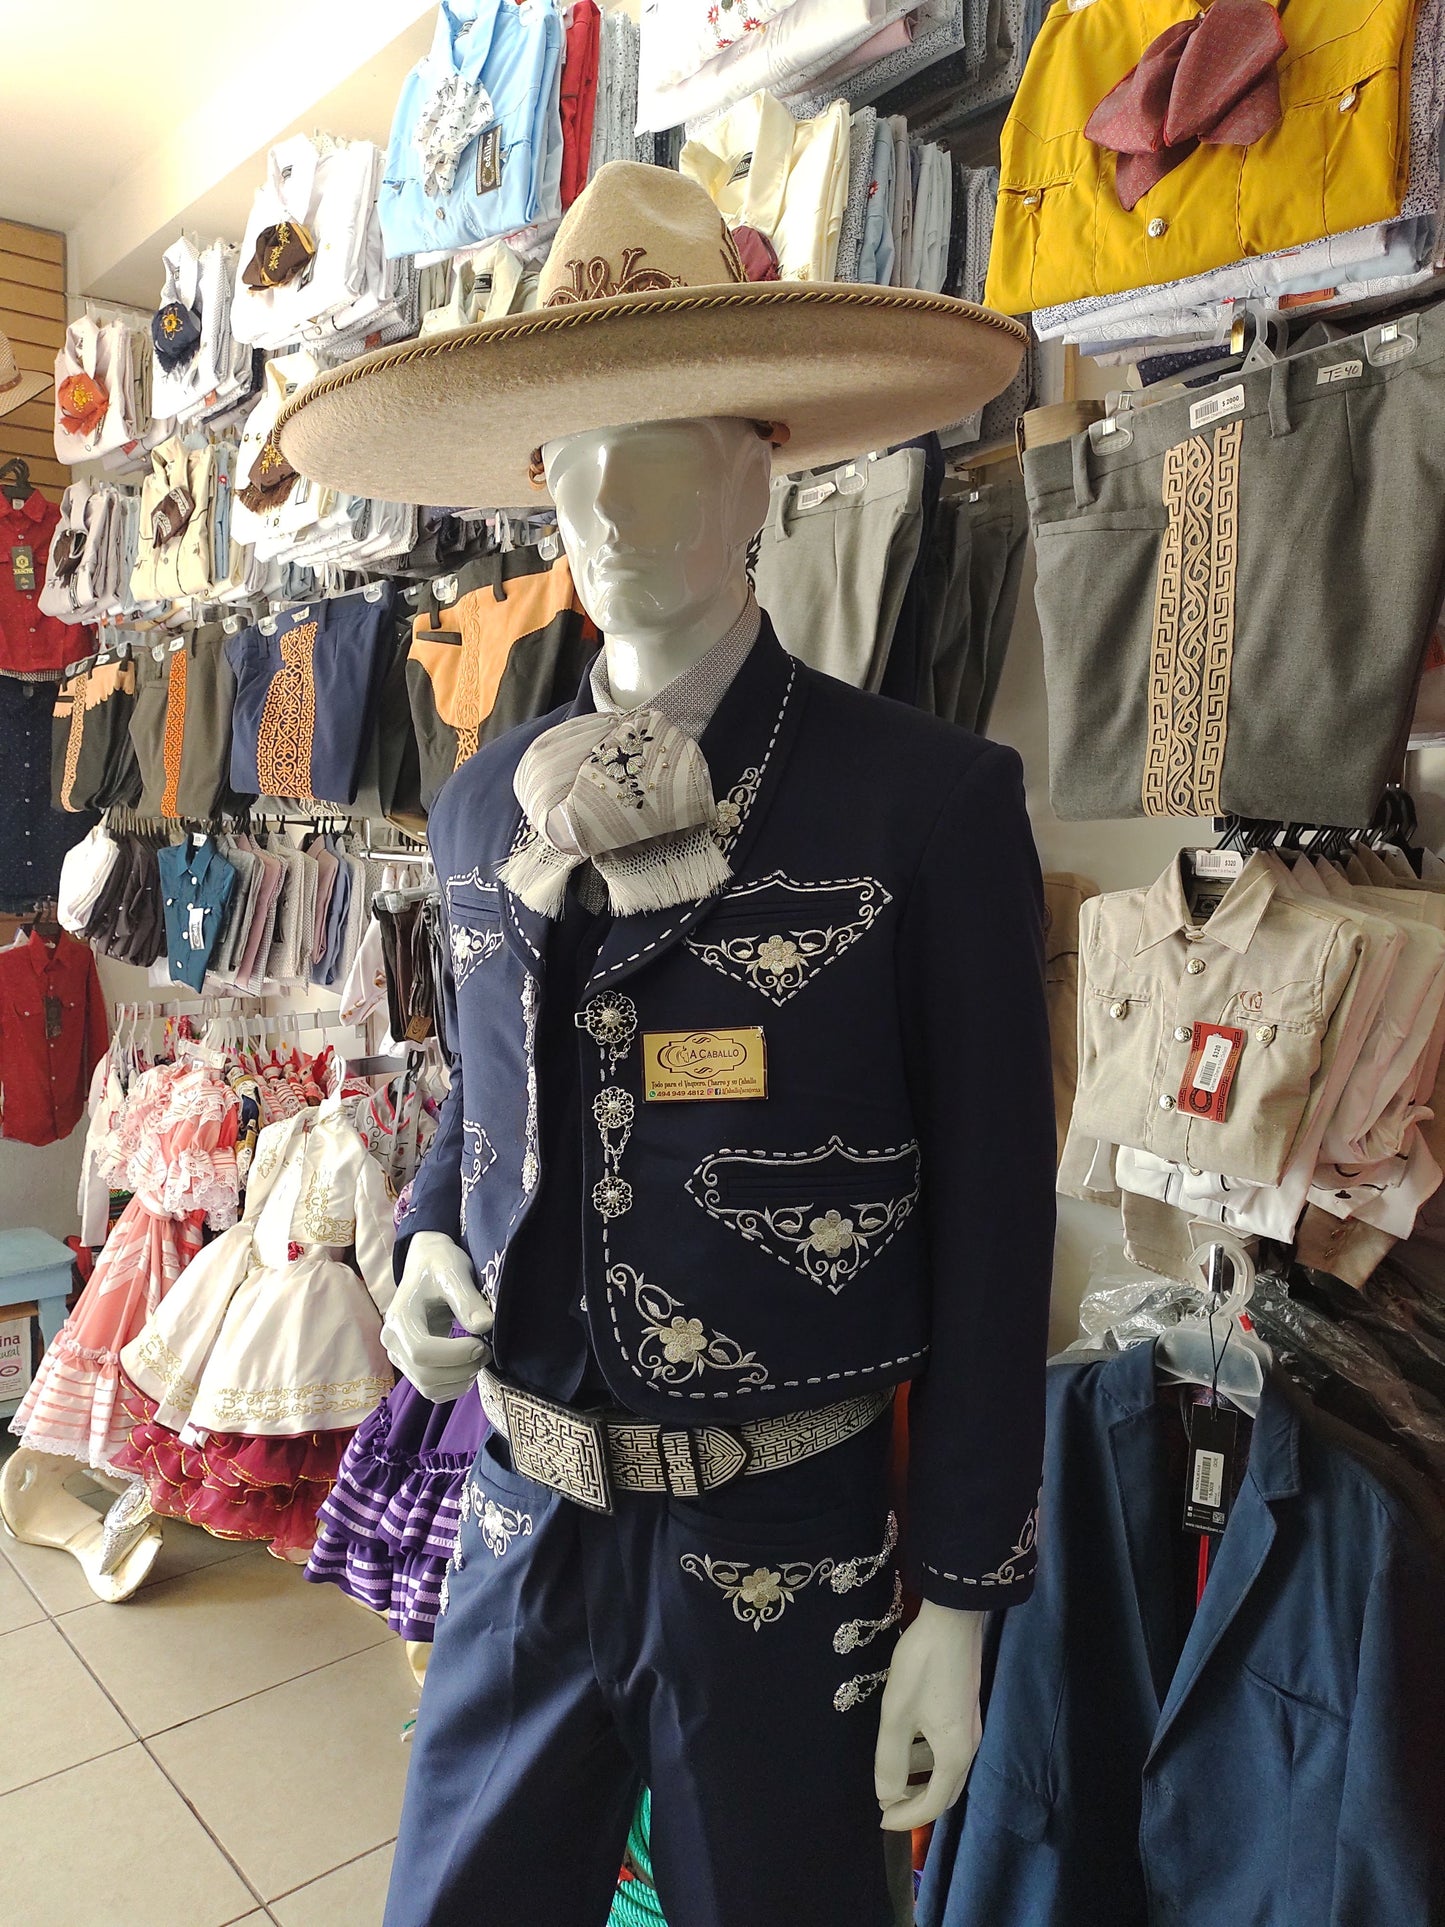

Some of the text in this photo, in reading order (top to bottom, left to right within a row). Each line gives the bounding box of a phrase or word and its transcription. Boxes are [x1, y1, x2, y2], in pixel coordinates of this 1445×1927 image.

[690, 1049, 739, 1059] A CABALLO
[664, 1081, 677, 1089] para
[678, 1079, 683, 1087] el
